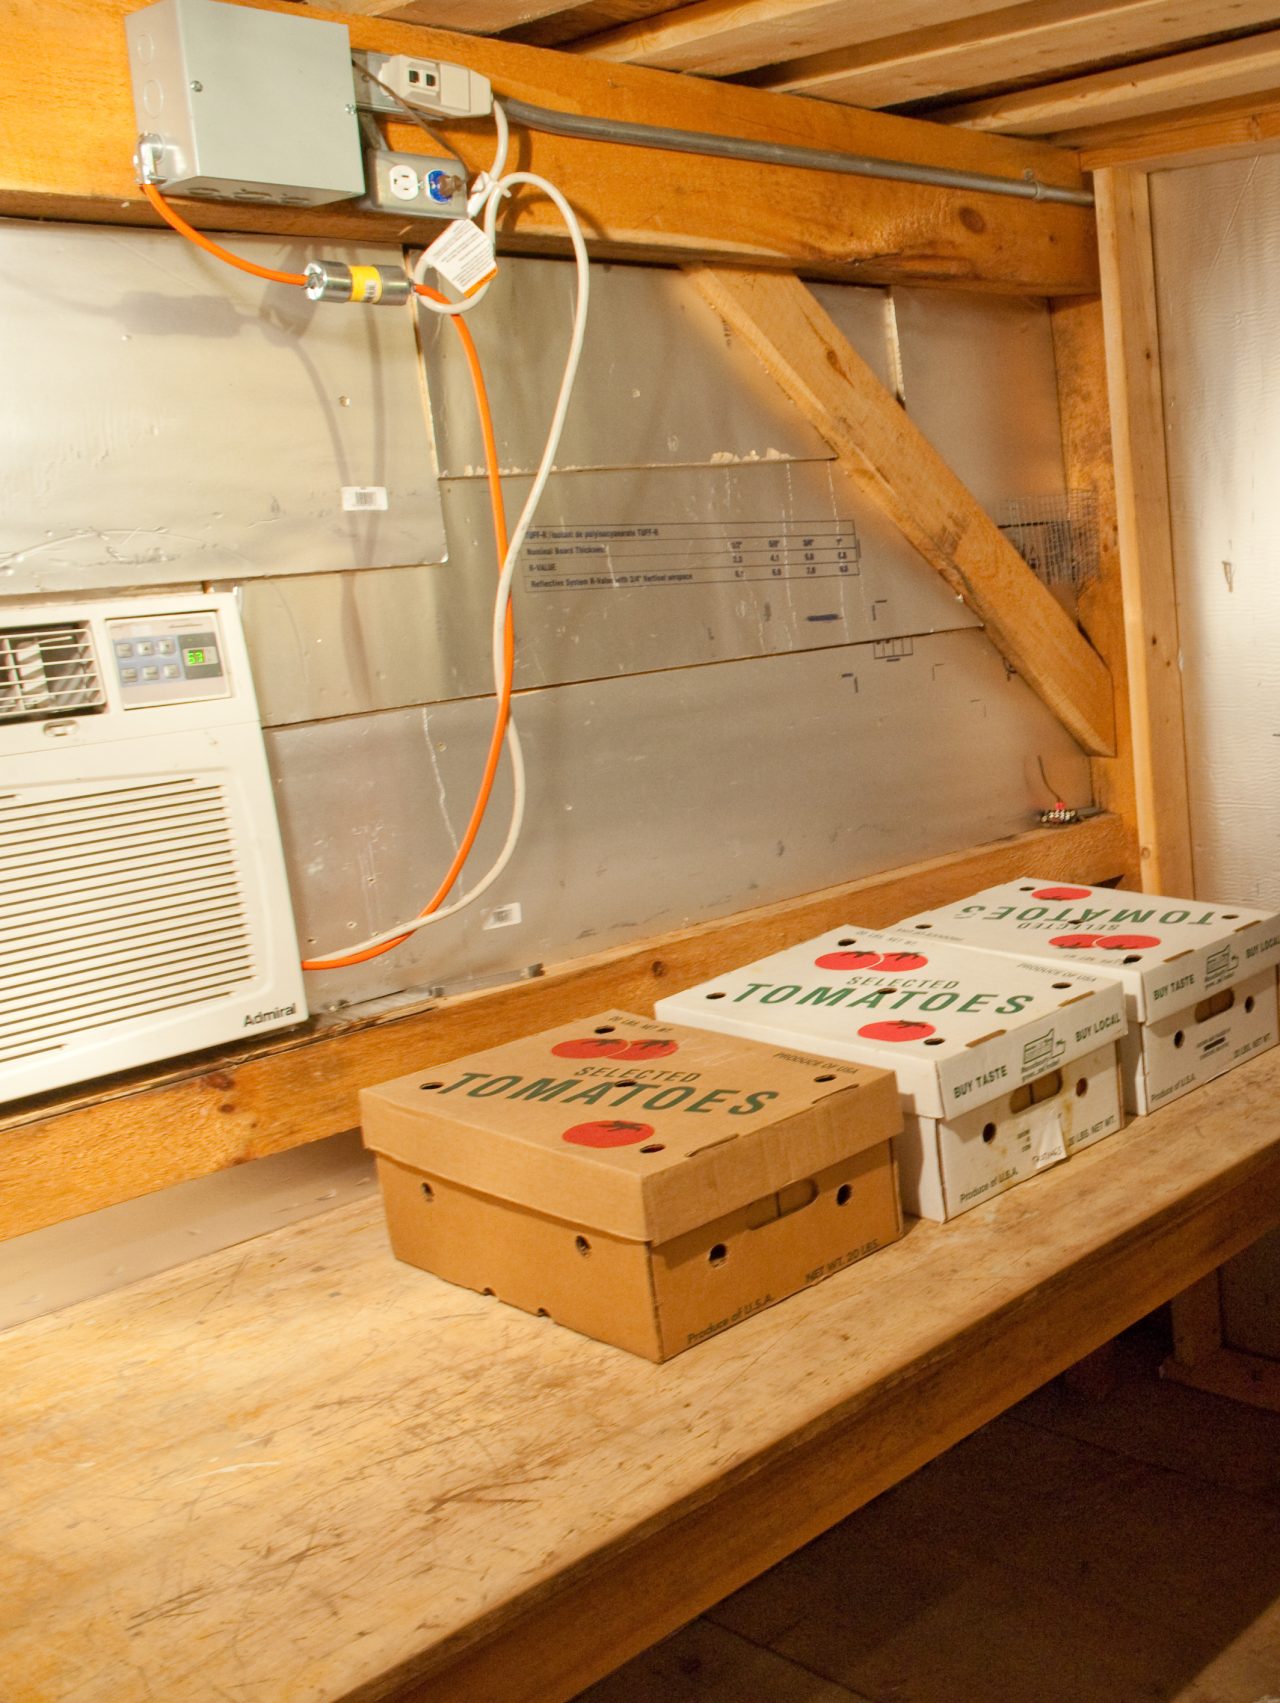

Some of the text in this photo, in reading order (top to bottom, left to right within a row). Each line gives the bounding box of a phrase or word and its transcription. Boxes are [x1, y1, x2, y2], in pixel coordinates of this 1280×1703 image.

[954, 904, 1215, 926] TOMATOES
[1017, 922, 1119, 932] SELECTED
[1246, 946, 1259, 959] BUY
[1260, 937, 1280, 952] LOCAL
[846, 976, 961, 990] SELECTED
[1017, 962, 1063, 978] PRODUCE
[1076, 973, 1098, 983] USA
[733, 982, 1034, 1014] TOMATOES
[1153, 986, 1168, 1000] BUY
[1170, 974, 1195, 990] TASTE
[243, 1002, 297, 1028] Admiral
[1075, 1013, 1121, 1042] BUY LOCAL
[574, 1066, 703, 1083] SELECTED
[773, 1052, 822, 1067] PRODUCE
[835, 1064, 860, 1075] USA
[438, 1072, 781, 1116] TOMATOES
[954, 1080, 974, 1100] BUY
[976, 1065, 1008, 1089] TASTE
[1091, 1120, 1104, 1135] NET
[960, 1182, 989, 1203] Produce
[990, 1177, 1000, 1188] of
[805, 1265, 825, 1283] NET
[847, 1248, 860, 1264] 20
[687, 1317, 729, 1345] Produce
[731, 1306, 743, 1322] of
